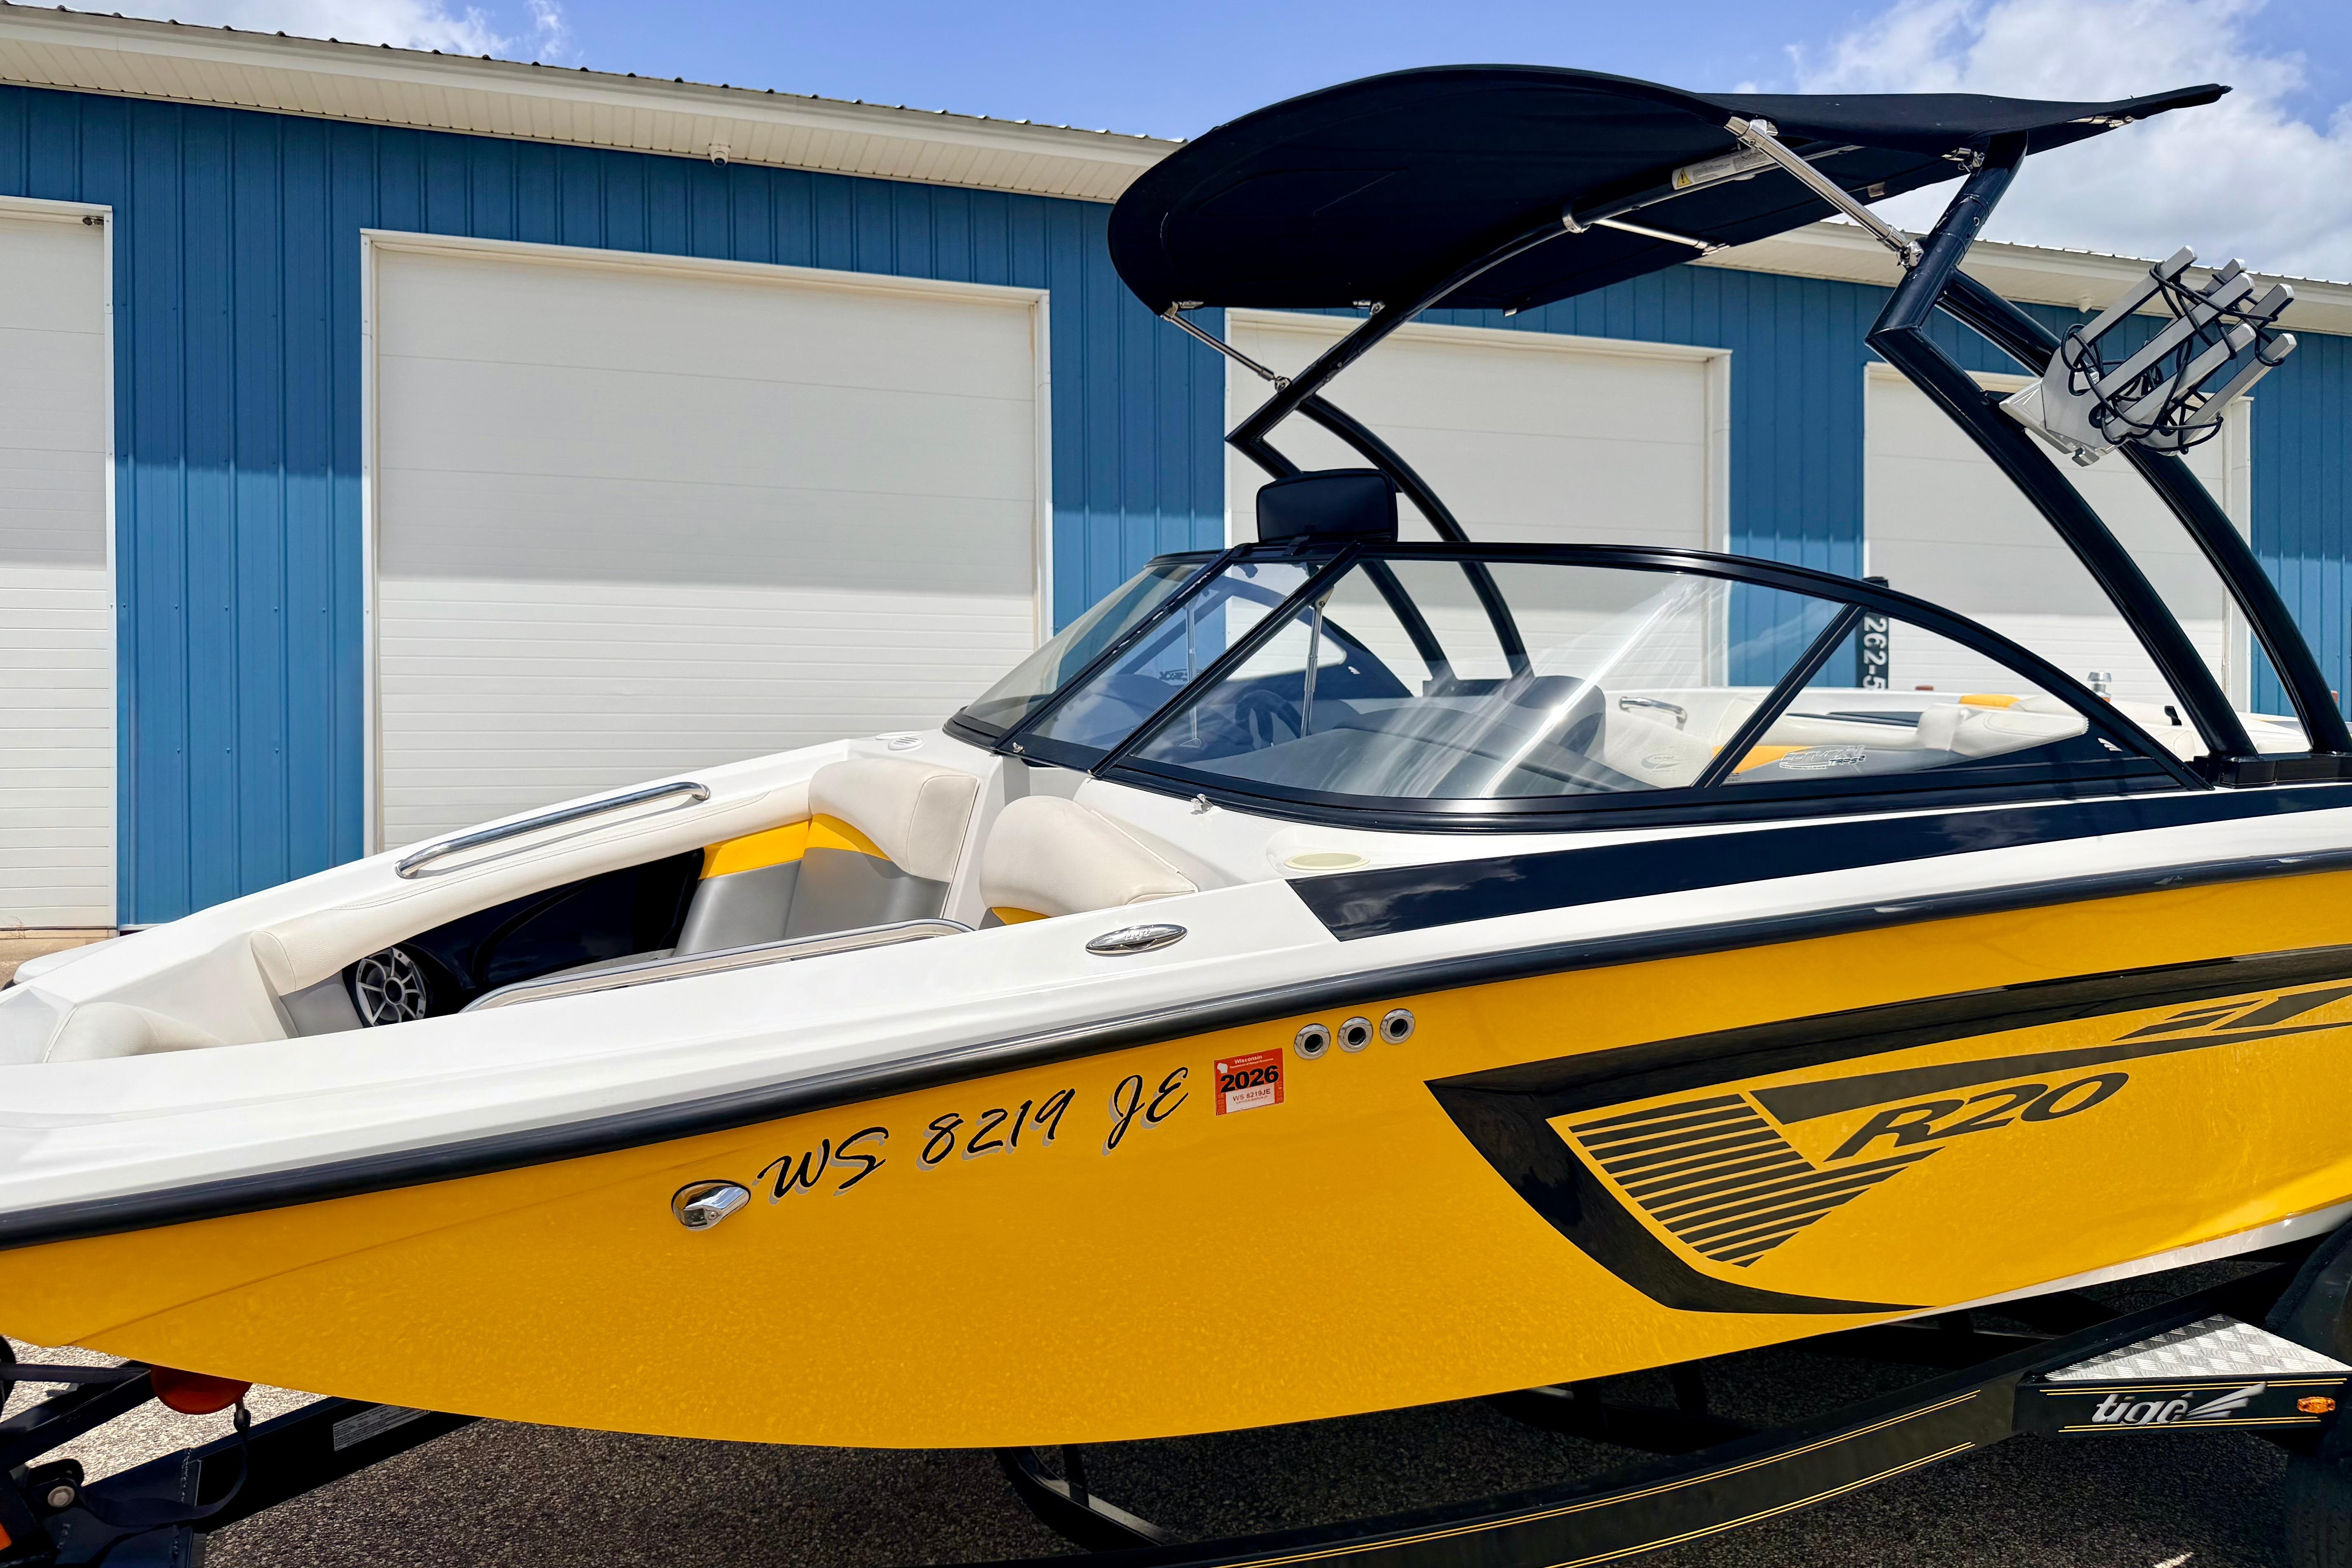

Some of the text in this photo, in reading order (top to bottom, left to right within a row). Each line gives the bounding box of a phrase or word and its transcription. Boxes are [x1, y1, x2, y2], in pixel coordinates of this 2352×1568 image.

[1234, 1055, 1262, 1064] Wisconsin
[1220, 1065, 1279, 1093] 2026
[1246, 1088, 1270, 1098] 8219JE
[1823, 1072, 2129, 1162] R20
[753, 1066, 1189, 1204] WS 8219 JE
